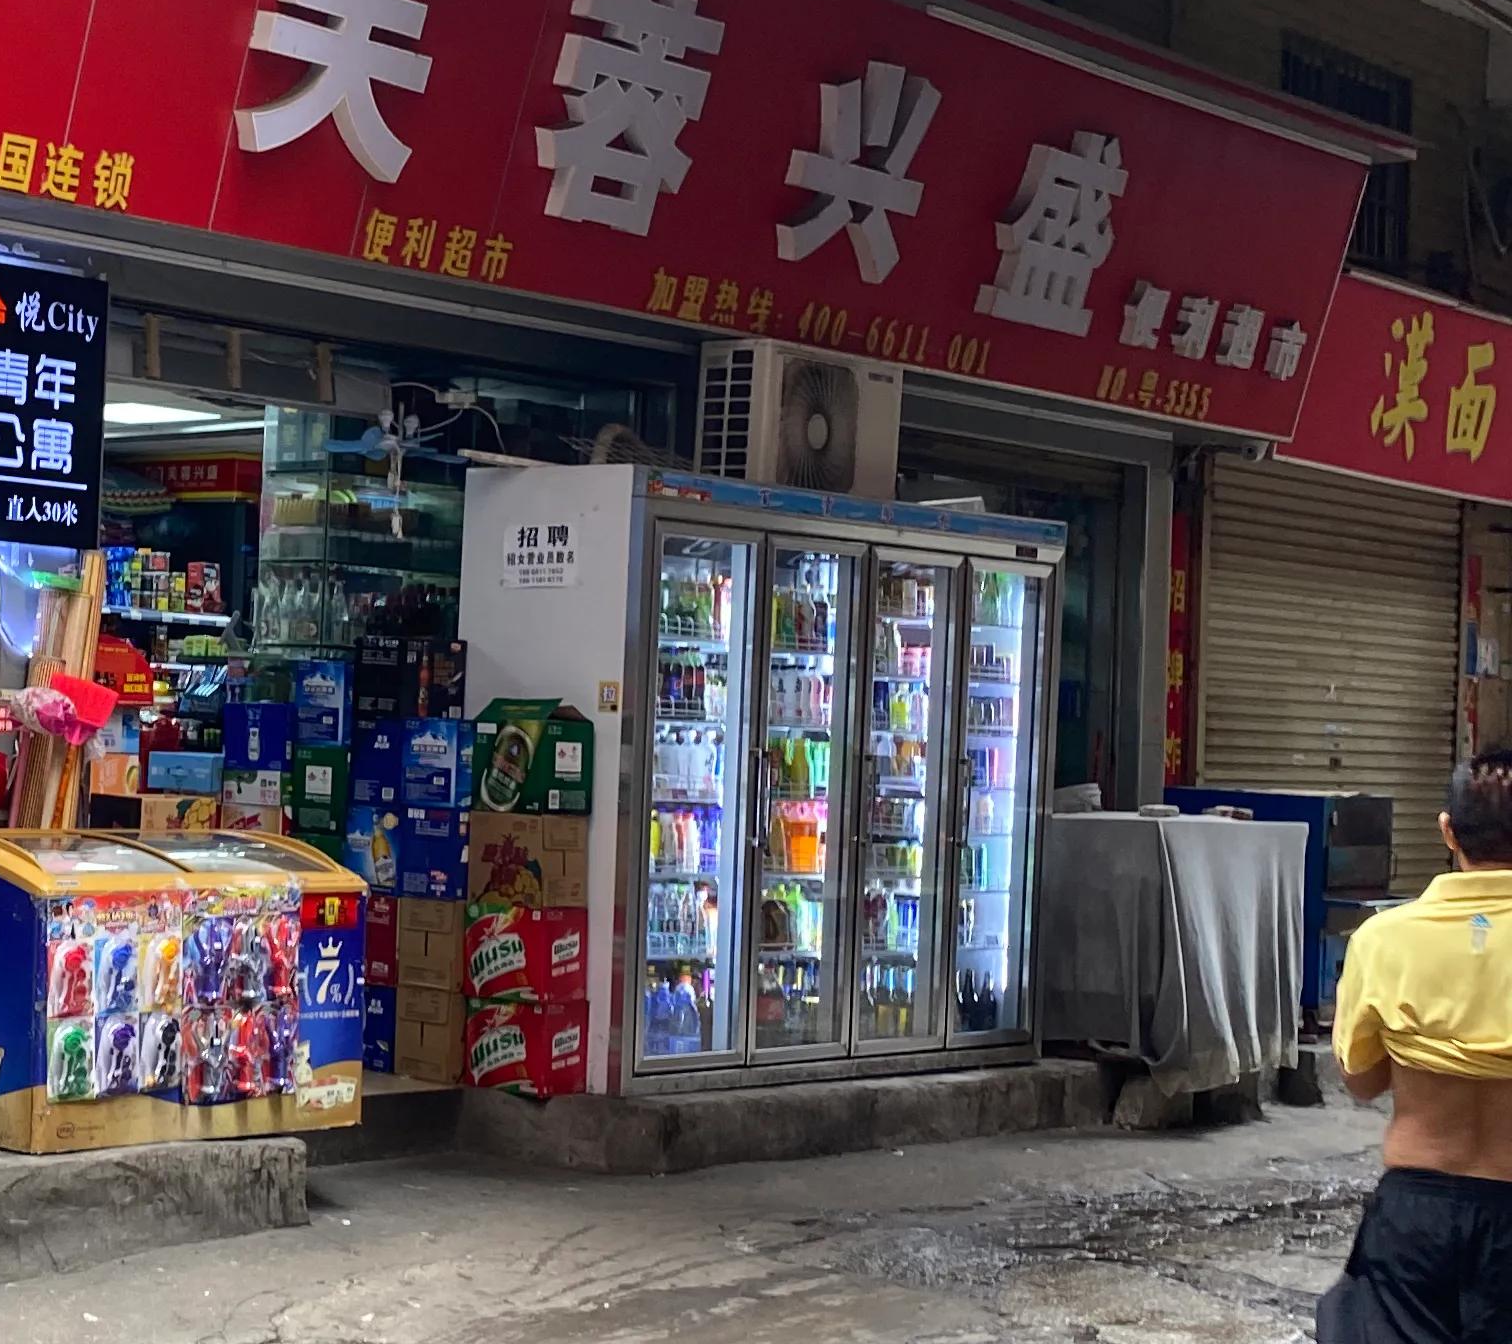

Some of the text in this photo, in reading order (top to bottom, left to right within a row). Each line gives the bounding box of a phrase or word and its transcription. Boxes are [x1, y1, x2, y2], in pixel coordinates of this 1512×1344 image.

[364, 207, 516, 283] 便利超市
[1118, 278, 1309, 382] 便利超市
[517, 524, 569, 548] 招聘
